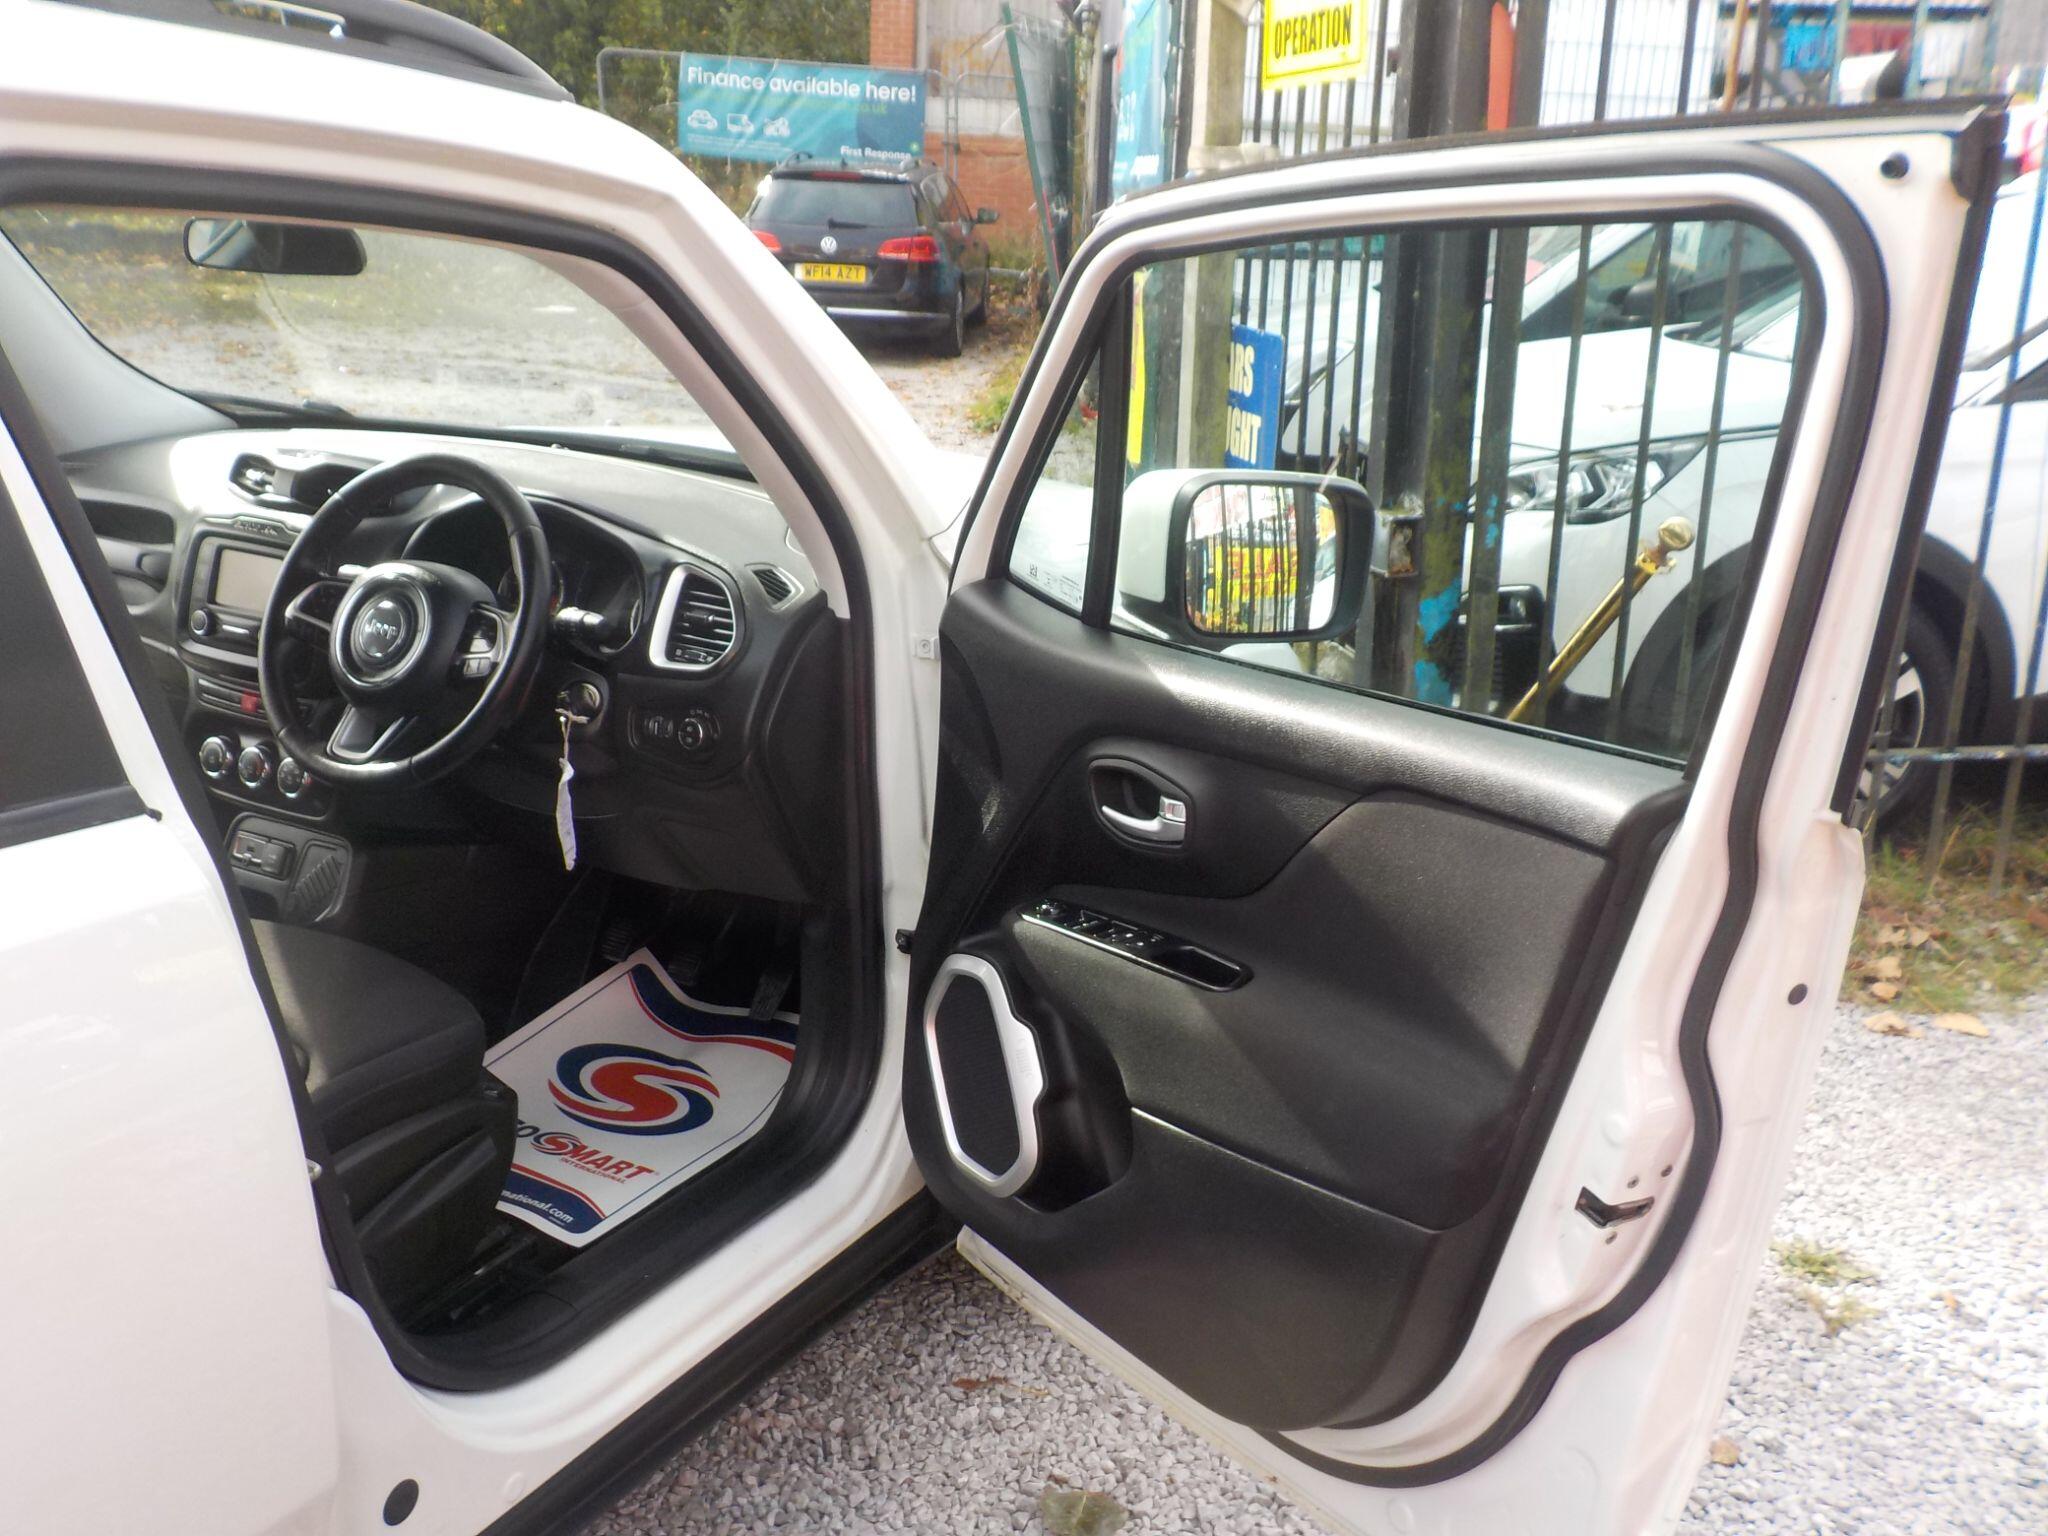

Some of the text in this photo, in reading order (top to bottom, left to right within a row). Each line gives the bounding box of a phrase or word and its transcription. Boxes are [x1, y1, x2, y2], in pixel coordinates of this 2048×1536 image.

[1274, 3, 1352, 59] OPERATION
[687, 67, 917, 103] Finance available here!
[840, 145, 862, 157] First
[365, 619, 398, 640] Jeep
